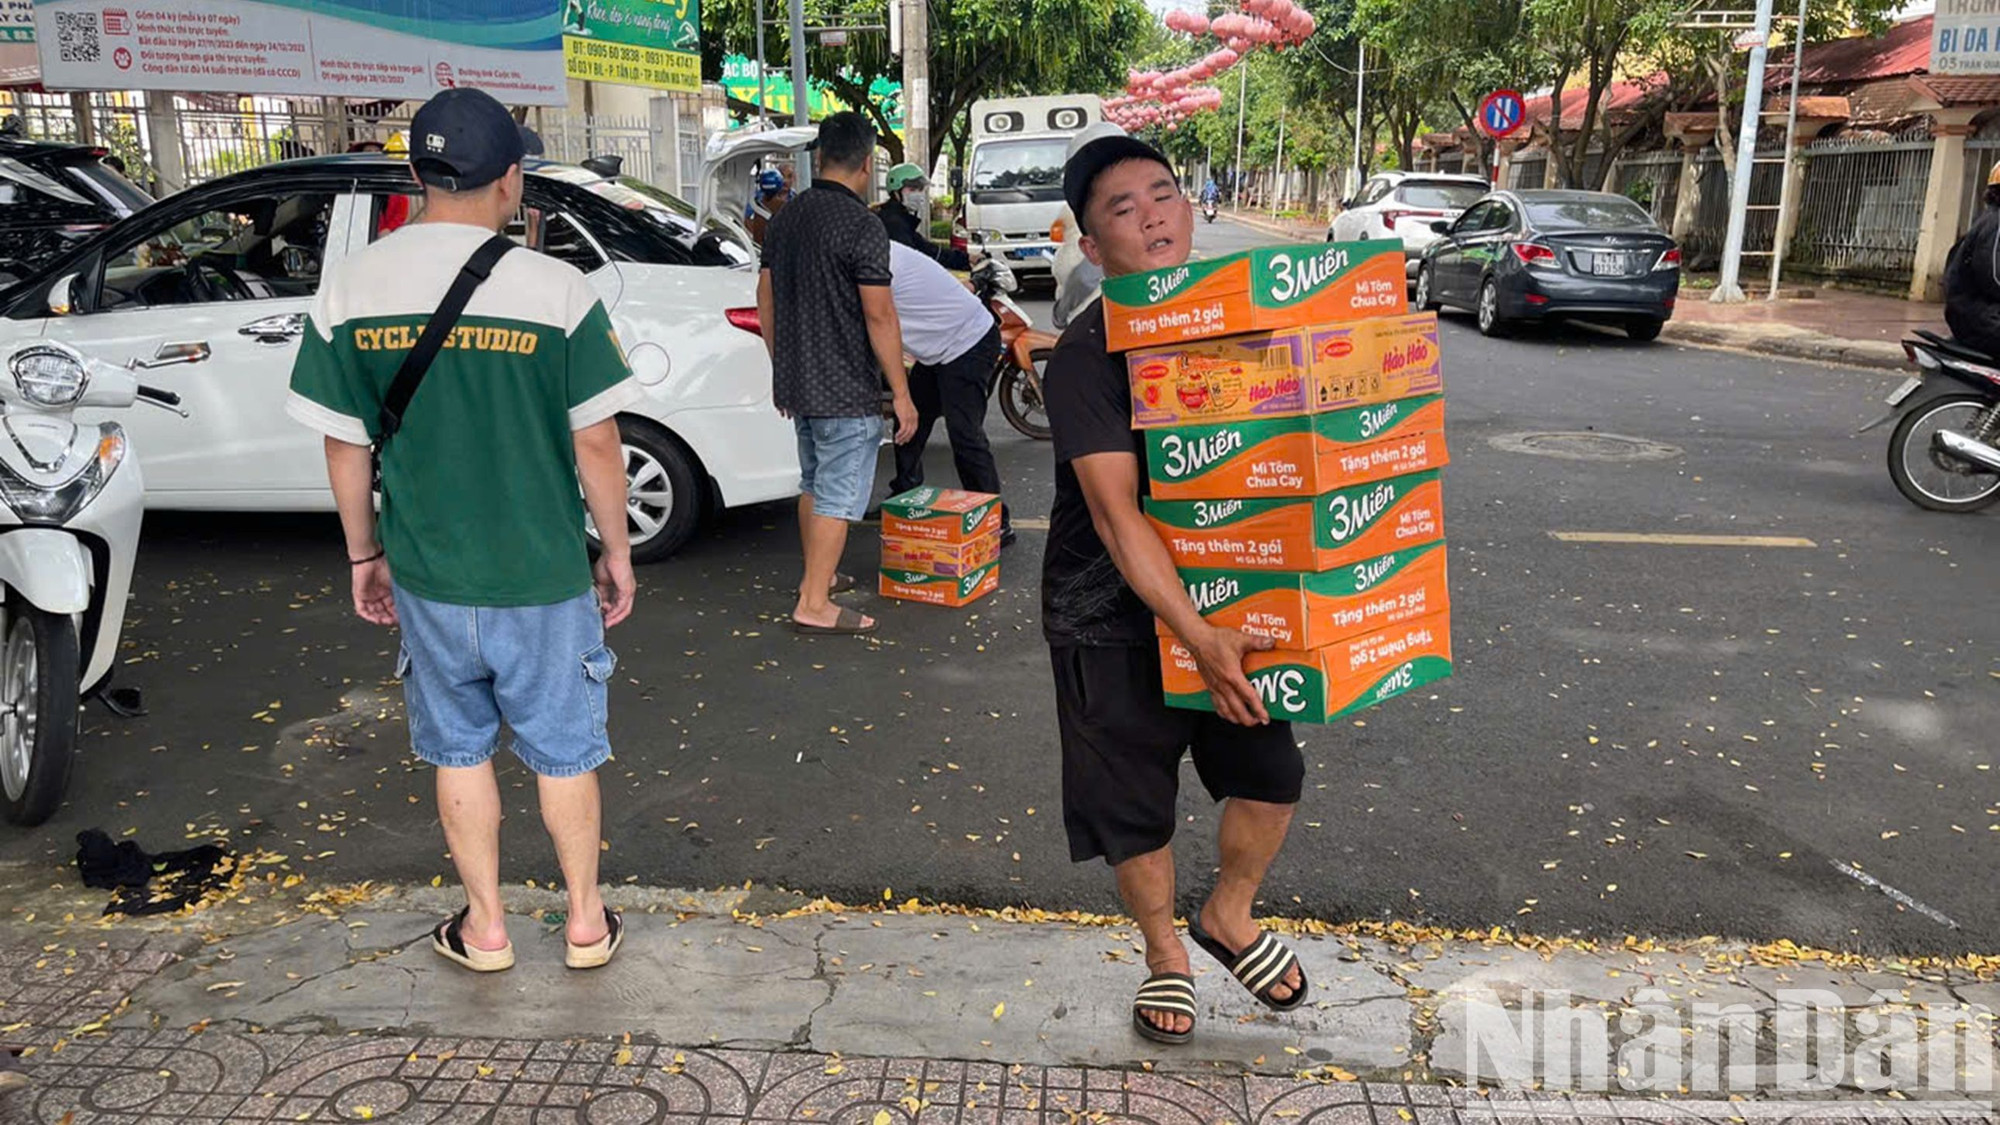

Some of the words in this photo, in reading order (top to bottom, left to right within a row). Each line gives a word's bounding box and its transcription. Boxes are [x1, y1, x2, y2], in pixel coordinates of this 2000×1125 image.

[1939, 28, 1959, 52] BI
[1963, 27, 1988, 52] DA
[1350, 295, 1377, 309] Chua
[1378, 293, 1397, 307] Cay
[1128, 318, 1157, 336] Tặng
[1158, 311, 1191, 328] thêm
[1193, 308, 1201, 323] 2
[1203, 302, 1224, 324] gói
[354, 325, 427, 349] CYCL
[1340, 457, 1369, 473] Tặng
[1371, 448, 1400, 464] thêm
[1401, 445, 1408, 458] 2
[1409, 440, 1426, 460] gói
[1252, 462, 1266, 474] Mì
[1269, 461, 1296, 474] Tôm
[1246, 477, 1278, 488] Chua
[1279, 475, 1303, 488] Cay
[1172, 539, 1205, 555] Tặng
[1208, 539, 1244, 553] thêm
[1248, 540, 1256, 552] 2
[1258, 539, 1282, 555] gói
[1332, 609, 1363, 627] Tặng
[1365, 599, 1396, 617] thêm
[1399, 594, 1406, 607] 2
[1407, 586, 1425, 608] gói
[1241, 625, 1269, 637] Chua
[1271, 628, 1292, 642] Cay
